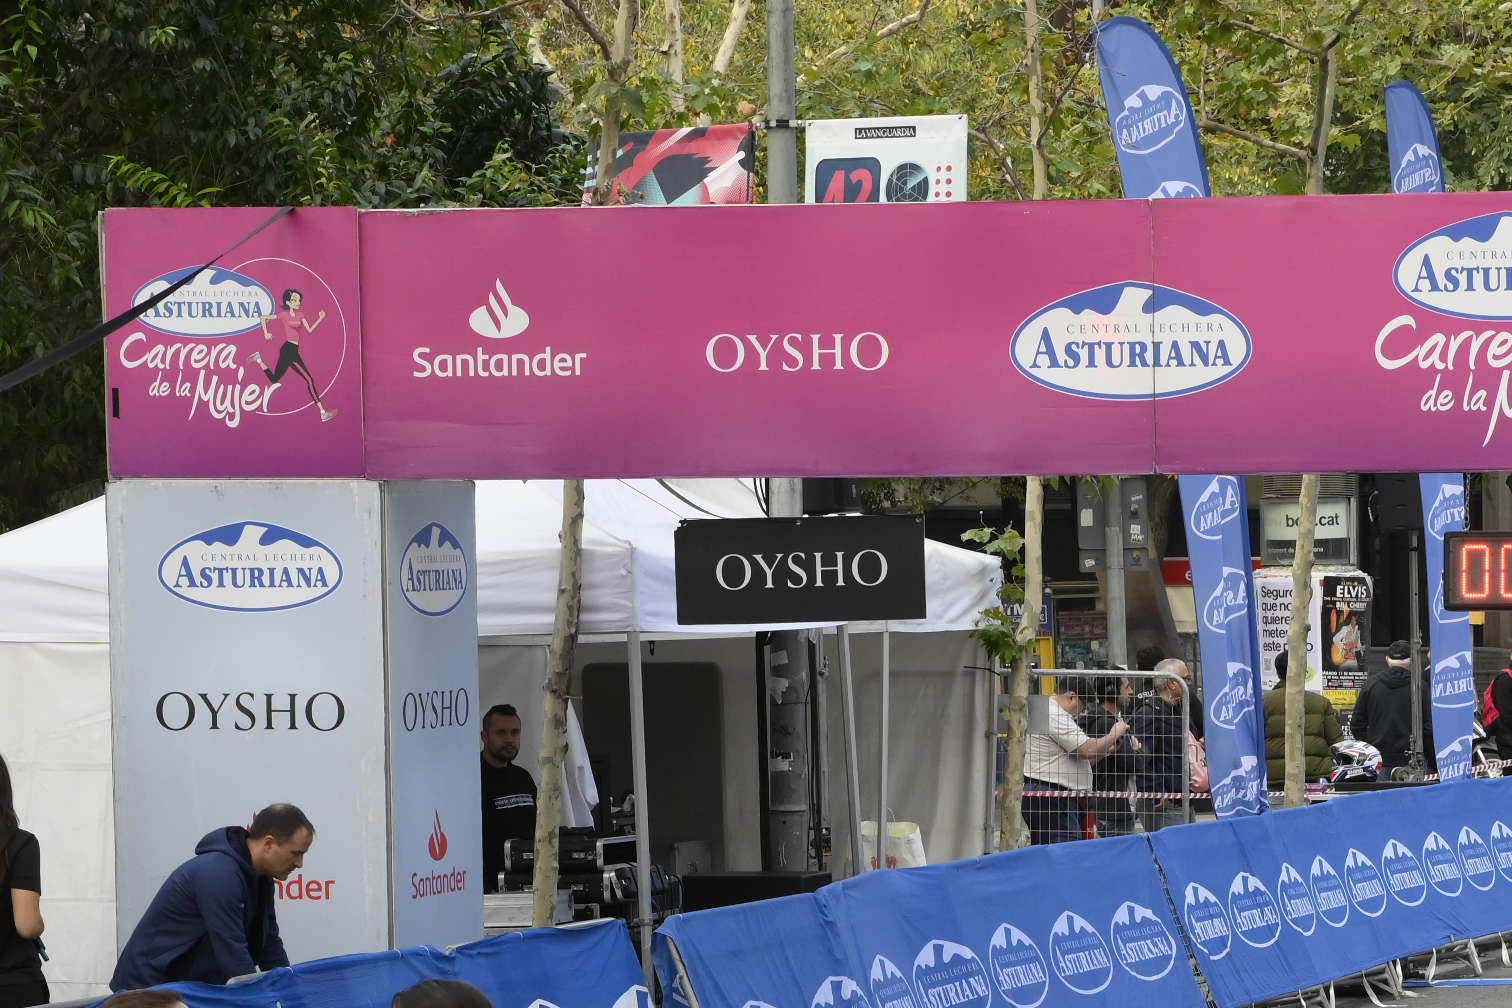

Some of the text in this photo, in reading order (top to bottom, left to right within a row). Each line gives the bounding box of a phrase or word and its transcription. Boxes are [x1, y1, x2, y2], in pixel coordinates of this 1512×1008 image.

[143, 292, 263, 319] ASTURIANA
[169, 289, 210, 298] ENTRAL
[1066, 322, 1225, 335] CENTRAL LECHERA
[119, 332, 237, 369] Carrera
[412, 346, 587, 377] Santander
[705, 332, 890, 373] OYSHO
[1029, 326, 1233, 369] ASTURIANA
[149, 367, 282, 428] de la Mujer
[1420, 373, 1455, 412] de
[1463, 373, 1488, 412] la
[173, 554, 329, 589] ASTURIANA
[200, 552, 322, 563] CENTRAL LECHERA
[715, 549, 889, 591] OYSHO
[405, 558, 464, 593] ASTURIANA
[1336, 585, 1367, 598] ELVIS
[1262, 602, 1277, 614] que
[1263, 641, 1281, 651] este
[155, 691, 346, 732] OYSHO
[402, 687, 469, 732] OYSHO
[412, 867, 467, 899] Santander
